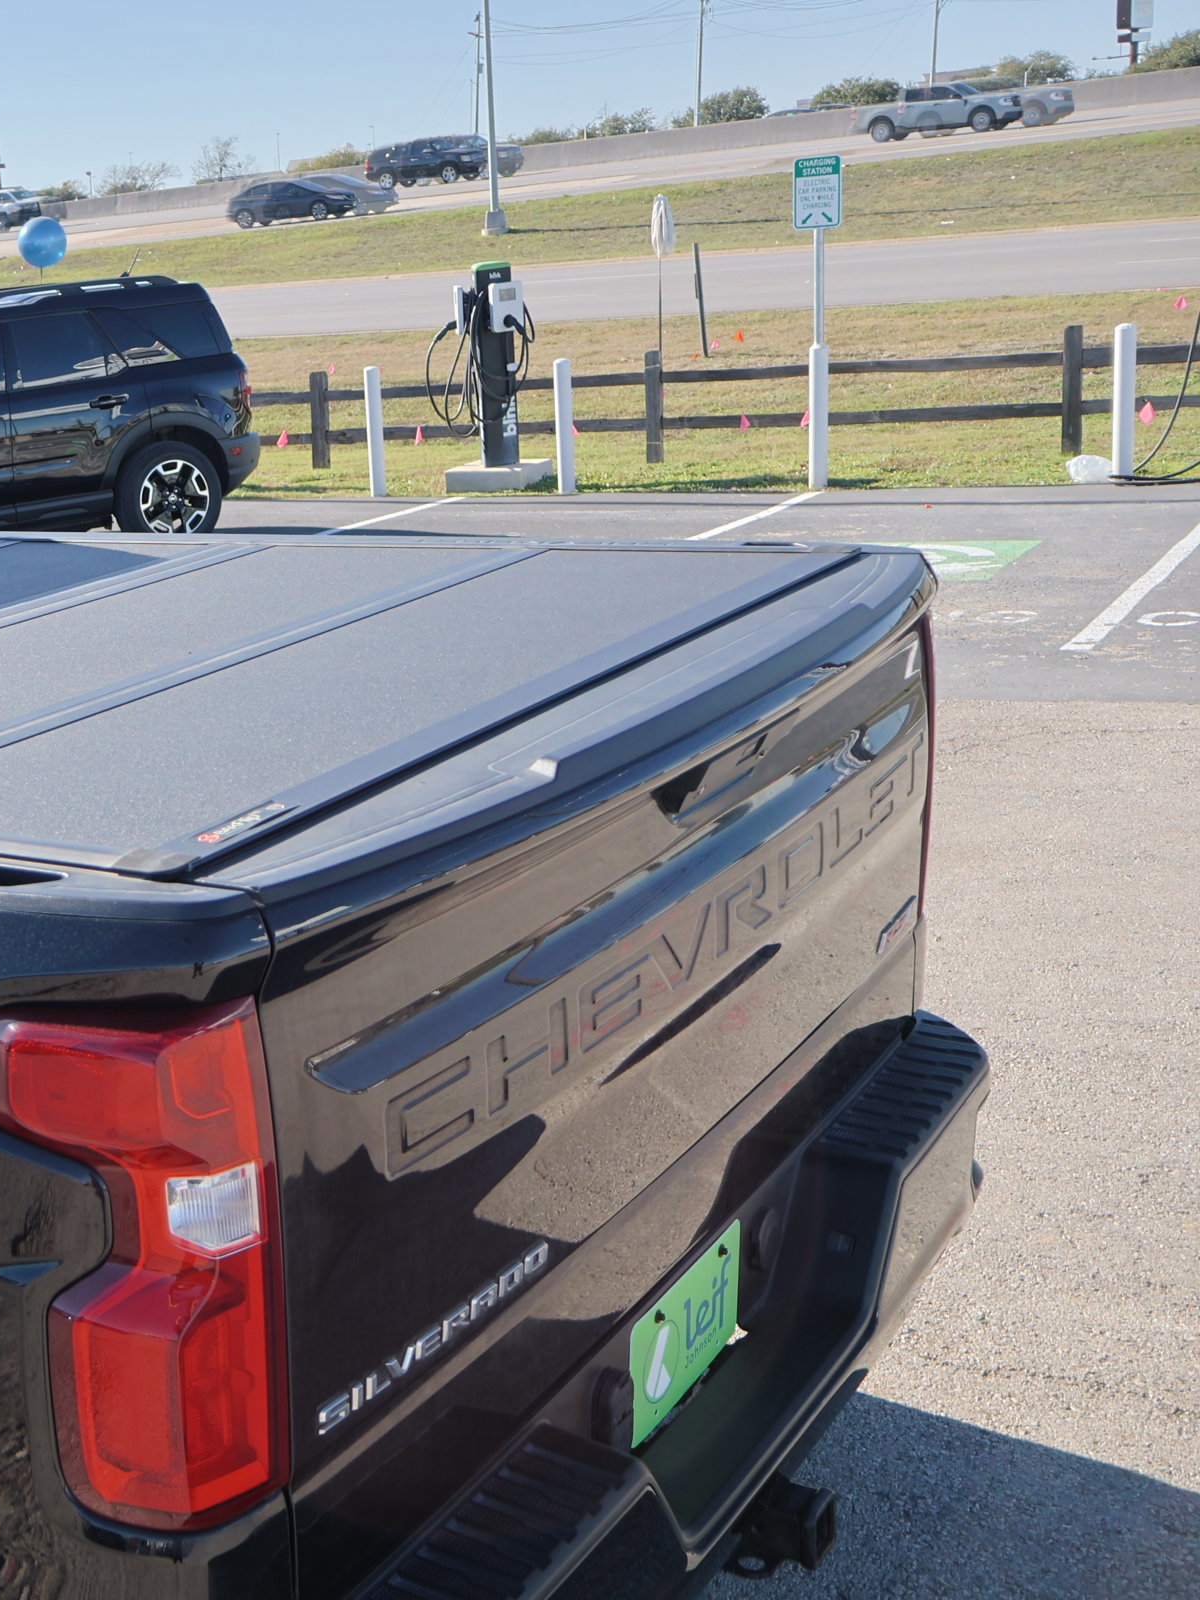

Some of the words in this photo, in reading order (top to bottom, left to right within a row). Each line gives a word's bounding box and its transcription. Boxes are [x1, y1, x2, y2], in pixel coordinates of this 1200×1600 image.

[798, 158, 836, 167] CHARGING
[802, 167, 832, 175] STATION
[804, 178, 831, 186] ELECTRIC
[799, 195, 816, 203] ONLY
[802, 201, 832, 210] CHARGING
[386, 731, 926, 1182] CHEVROLET
[318, 1241, 549, 1436] SILVERADO
[684, 1327, 718, 1370] Johnson
